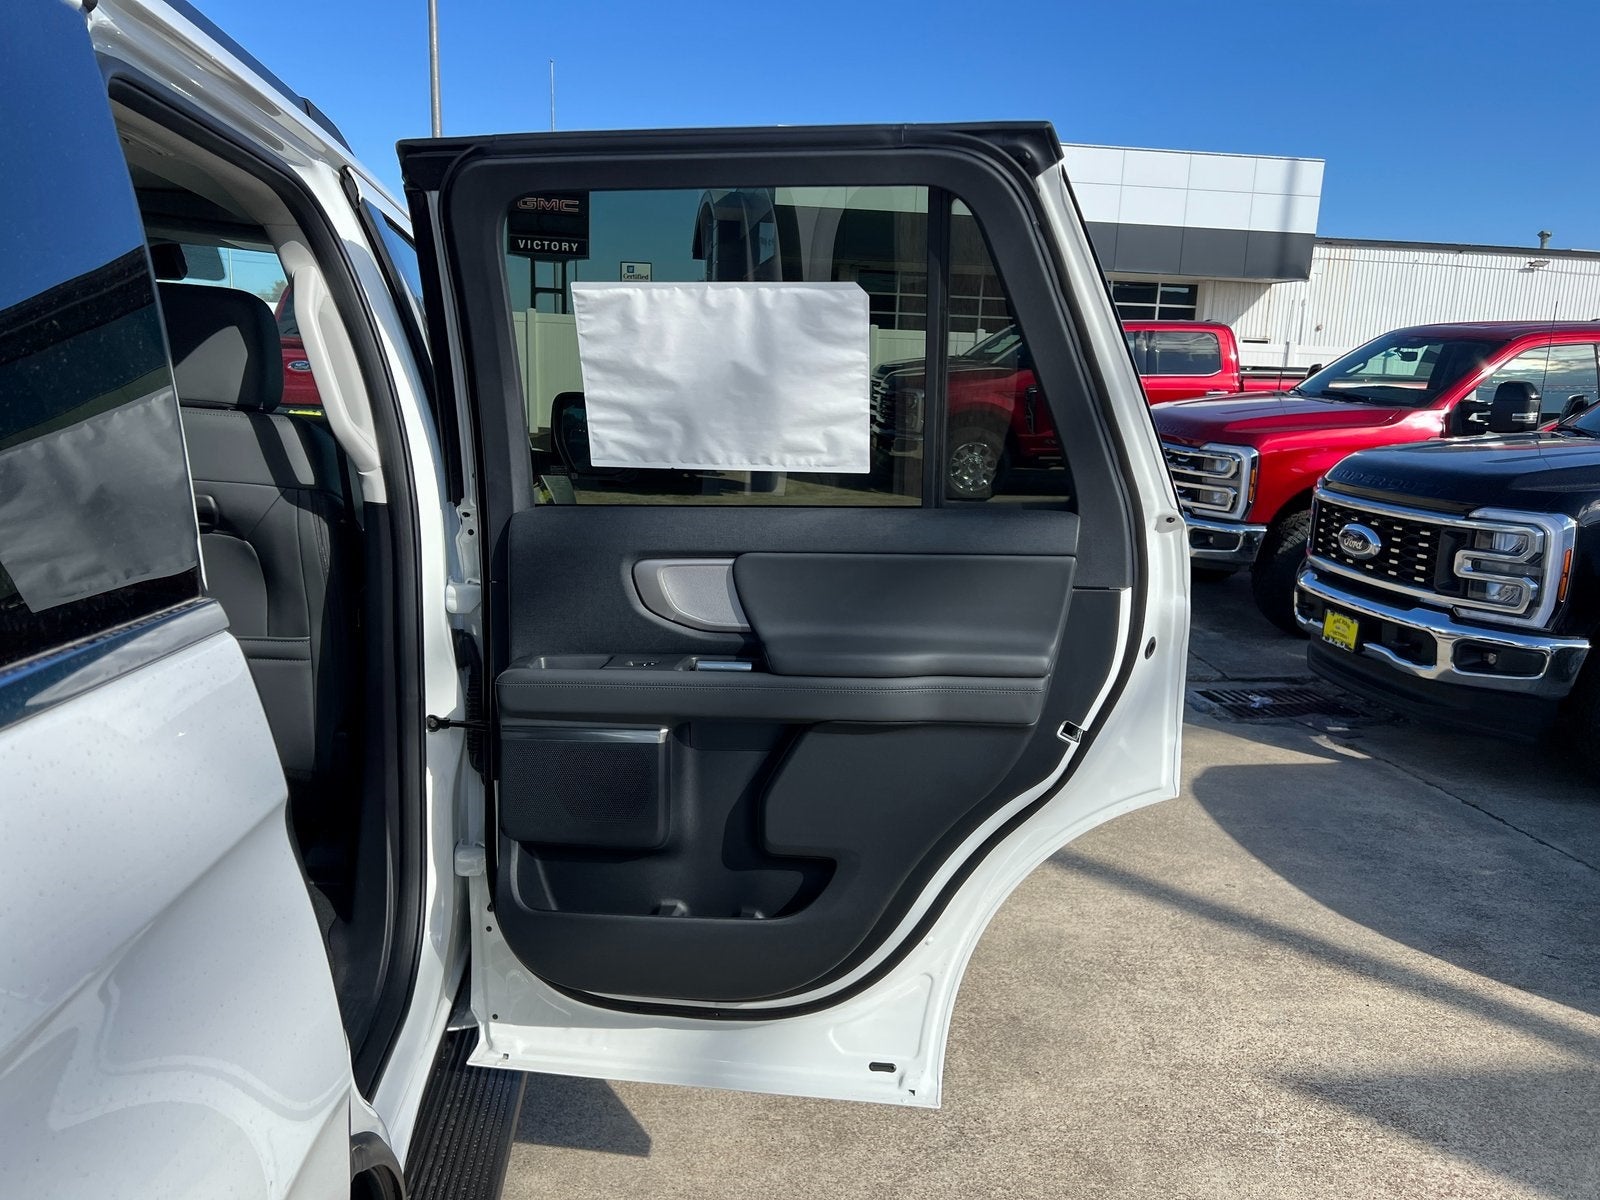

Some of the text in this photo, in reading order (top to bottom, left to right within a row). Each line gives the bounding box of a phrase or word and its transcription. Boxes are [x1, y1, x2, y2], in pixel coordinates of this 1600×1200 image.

[517, 197, 580, 213] GMC
[518, 239, 579, 252] VICTORY
[1343, 535, 1364, 550] Ford
